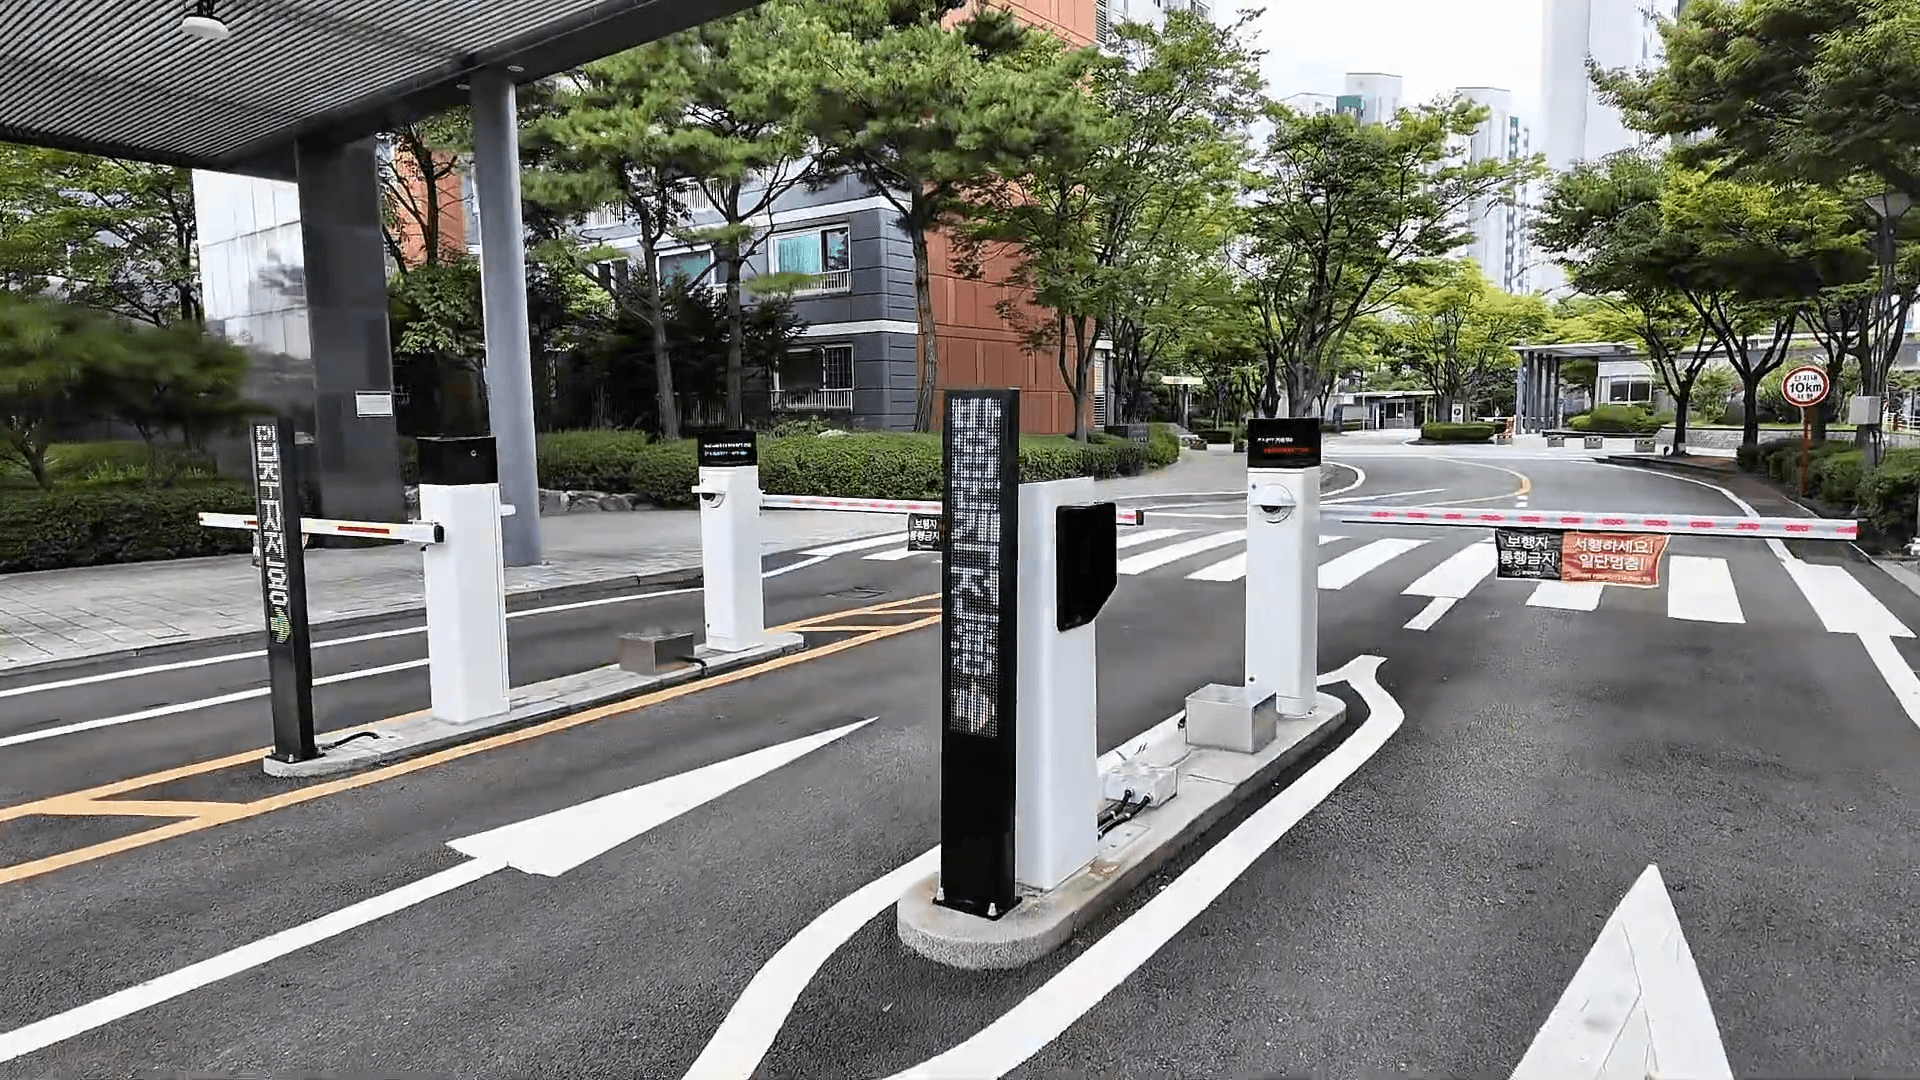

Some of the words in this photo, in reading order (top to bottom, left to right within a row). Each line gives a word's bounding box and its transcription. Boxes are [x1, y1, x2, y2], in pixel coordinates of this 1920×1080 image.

[1790, 382, 1822, 393] 10km
[1506, 535, 1549, 550] 보행자
[1574, 537, 1654, 554] 서행하세요!
[1500, 550, 1555, 567] 통행금지
